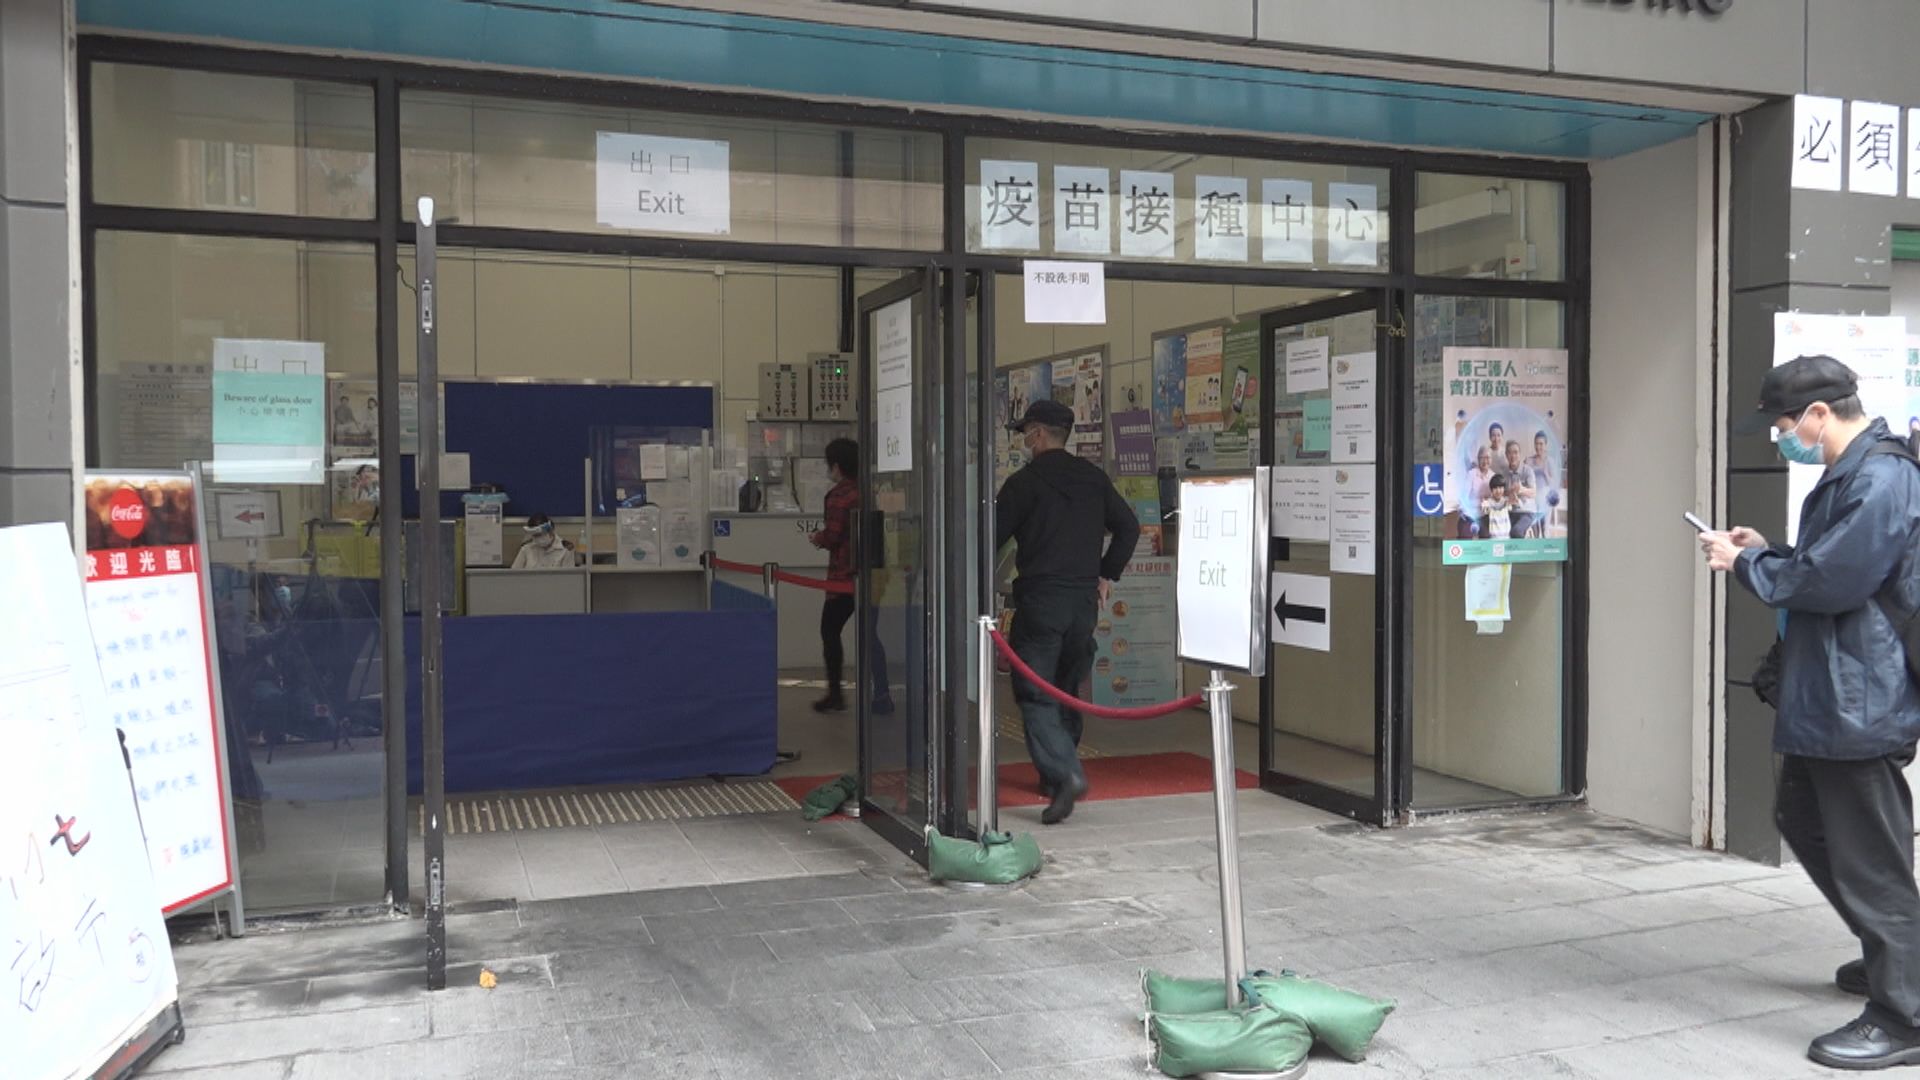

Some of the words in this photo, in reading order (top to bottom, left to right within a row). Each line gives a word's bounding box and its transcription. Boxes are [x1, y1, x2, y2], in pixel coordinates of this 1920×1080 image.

[630, 150, 690, 175] 出口
[638, 190, 685, 215] Exit
[985, 175, 1373, 242] 疫苗接種中心
[1033, 272, 1090, 286] 不設洗手間
[1458, 360, 1517, 377] 護己護人
[223, 393, 256, 403] Beware
[258, 394, 268, 403] of
[293, 396, 312, 404] door
[1450, 379, 1509, 397] 齊打疫苗
[886, 436, 901, 457] Exit
[1193, 506, 1237, 540] 出口
[1199, 560, 1227, 588] Exit
